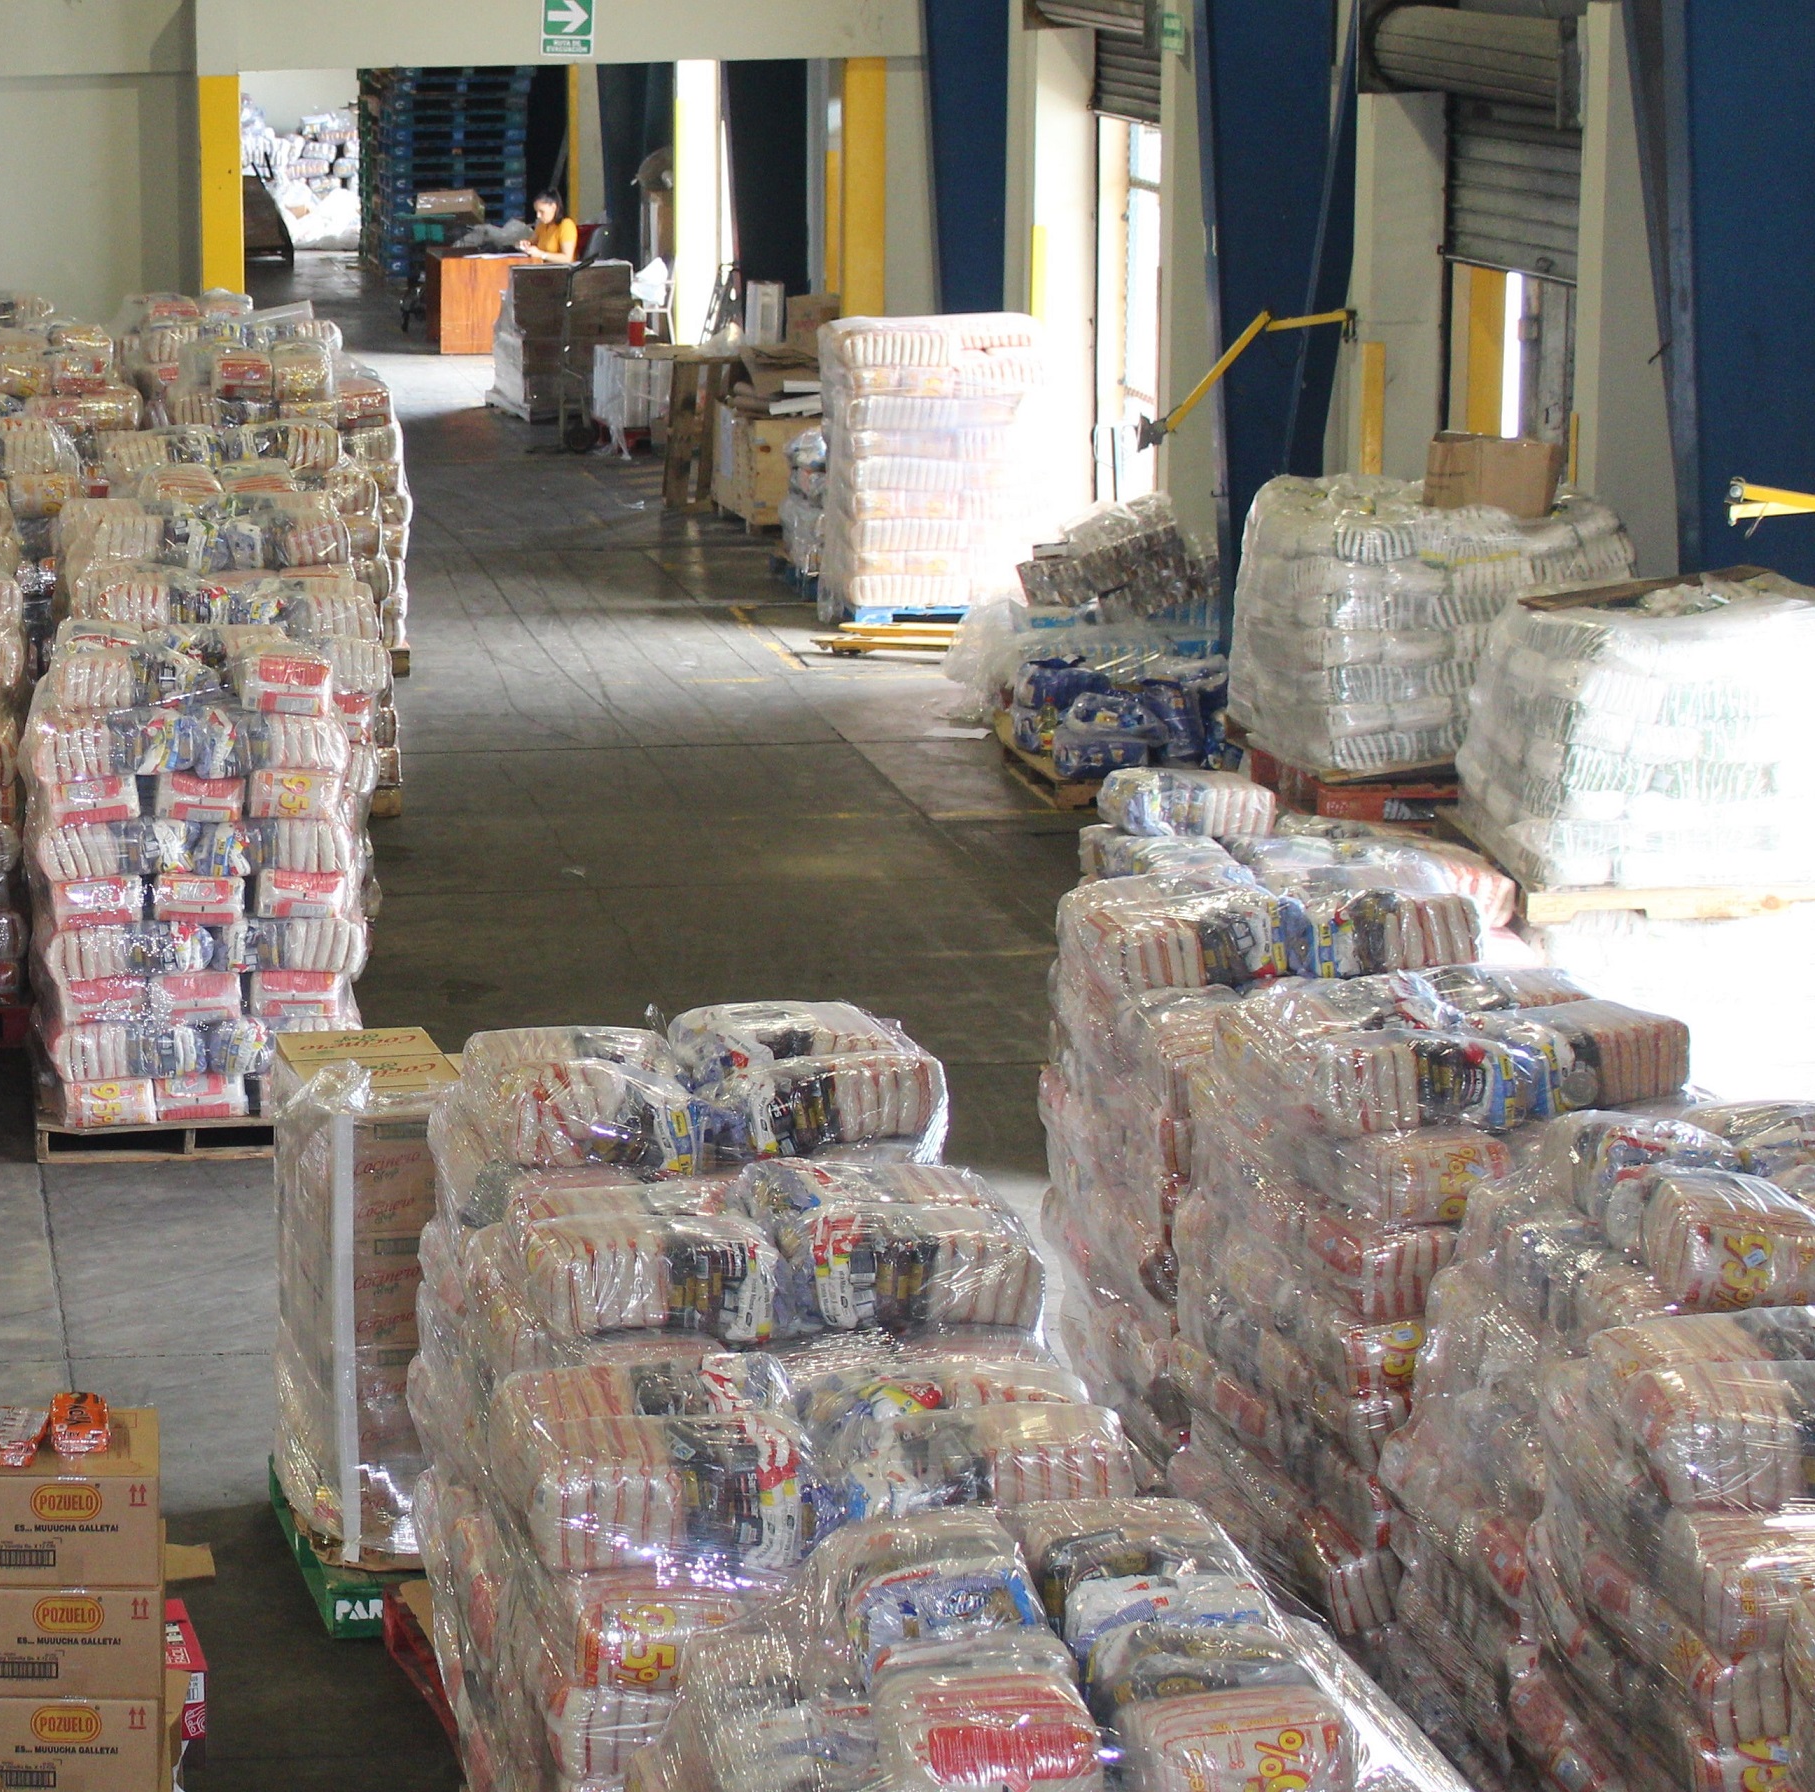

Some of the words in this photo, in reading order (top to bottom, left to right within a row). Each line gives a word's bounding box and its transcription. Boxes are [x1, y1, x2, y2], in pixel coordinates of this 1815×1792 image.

[299, 1035, 417, 1051] Cocinero
[39, 1494, 93, 1511] POZUELO
[42, 1607, 96, 1624] POZUELO
[40, 1716, 93, 1732] POZUELO
